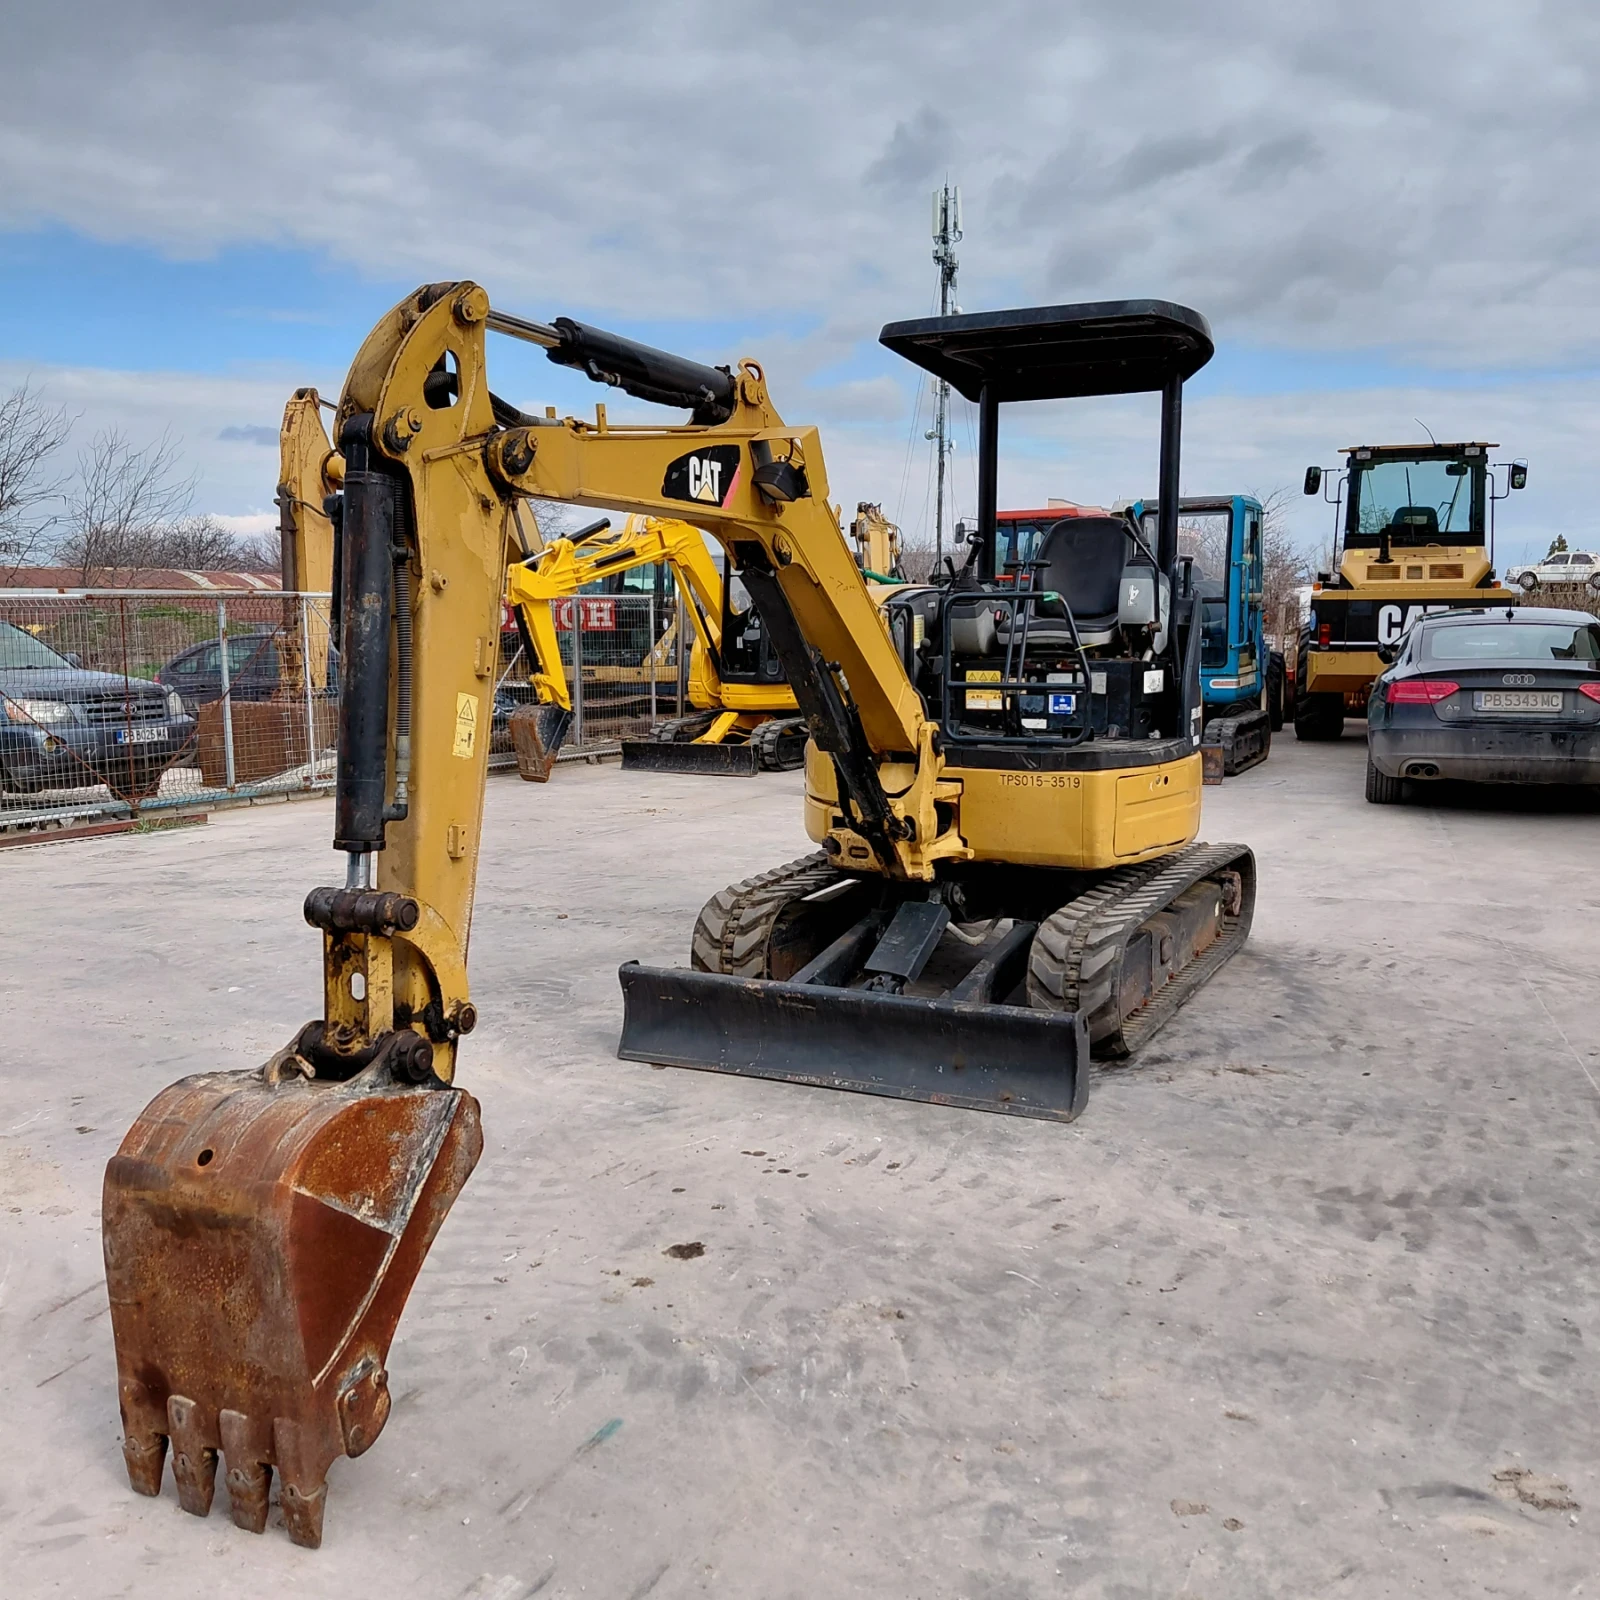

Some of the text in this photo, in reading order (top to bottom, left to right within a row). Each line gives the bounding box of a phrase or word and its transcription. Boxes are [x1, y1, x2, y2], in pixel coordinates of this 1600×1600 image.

[689, 456, 722, 503] CAT
[1483, 694, 1560, 707] PB 5343 MC
[1000, 774, 1081, 789] TPS015-3519
